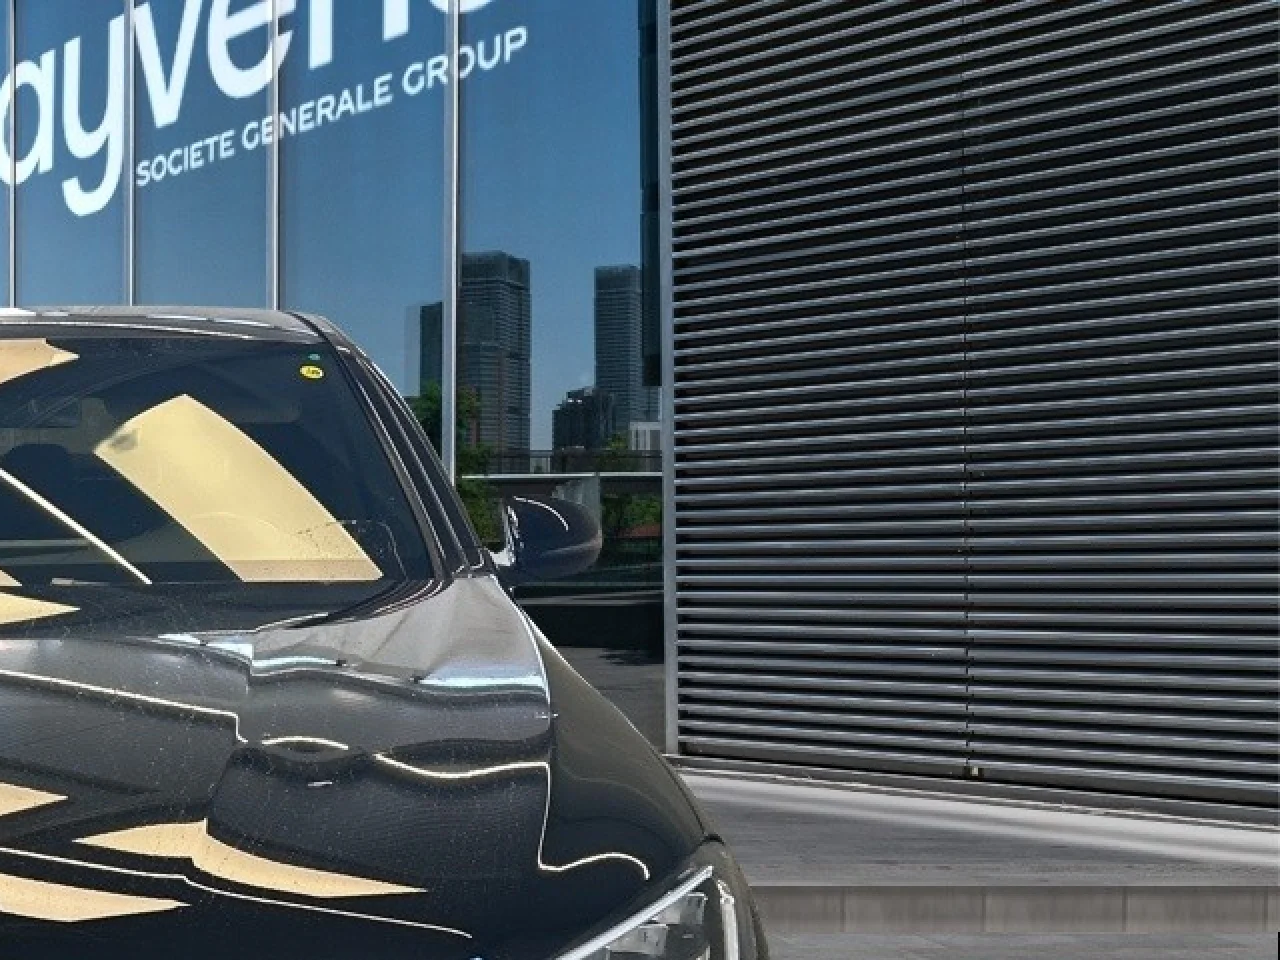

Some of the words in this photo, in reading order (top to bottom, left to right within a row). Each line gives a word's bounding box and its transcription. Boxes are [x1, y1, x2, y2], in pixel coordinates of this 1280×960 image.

[136, 129, 236, 187] SOCIETE
[241, 73, 393, 150] GENERALE
[401, 25, 528, 96] GROUP
